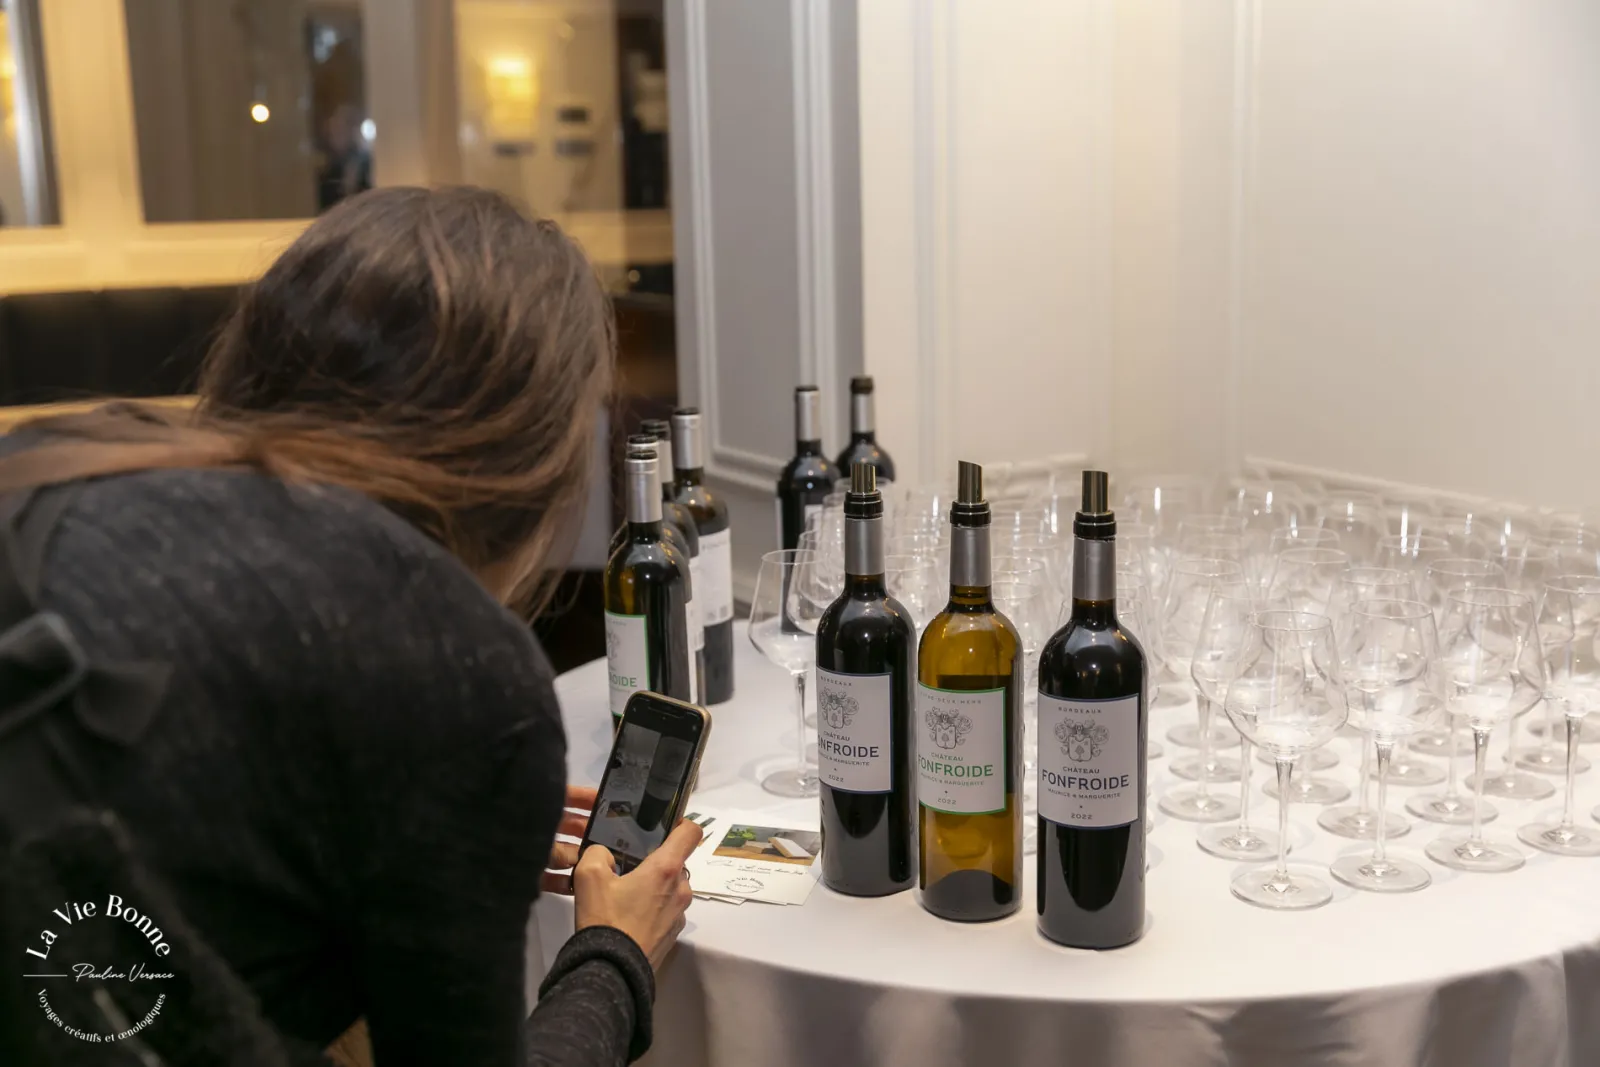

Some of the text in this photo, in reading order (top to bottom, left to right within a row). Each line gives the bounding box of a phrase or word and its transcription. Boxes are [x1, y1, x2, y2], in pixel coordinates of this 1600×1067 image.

[931, 752, 963, 762] CHÂTEAU
[1062, 766, 1100, 774] CHÂTEAU
[828, 774, 844, 783] 2022
[1042, 769, 1129, 790] FONFROIDE
[1048, 788, 1070, 798] MAURICE
[1079, 792, 1120, 800] MARGUERITE
[937, 797, 957, 805] 2022
